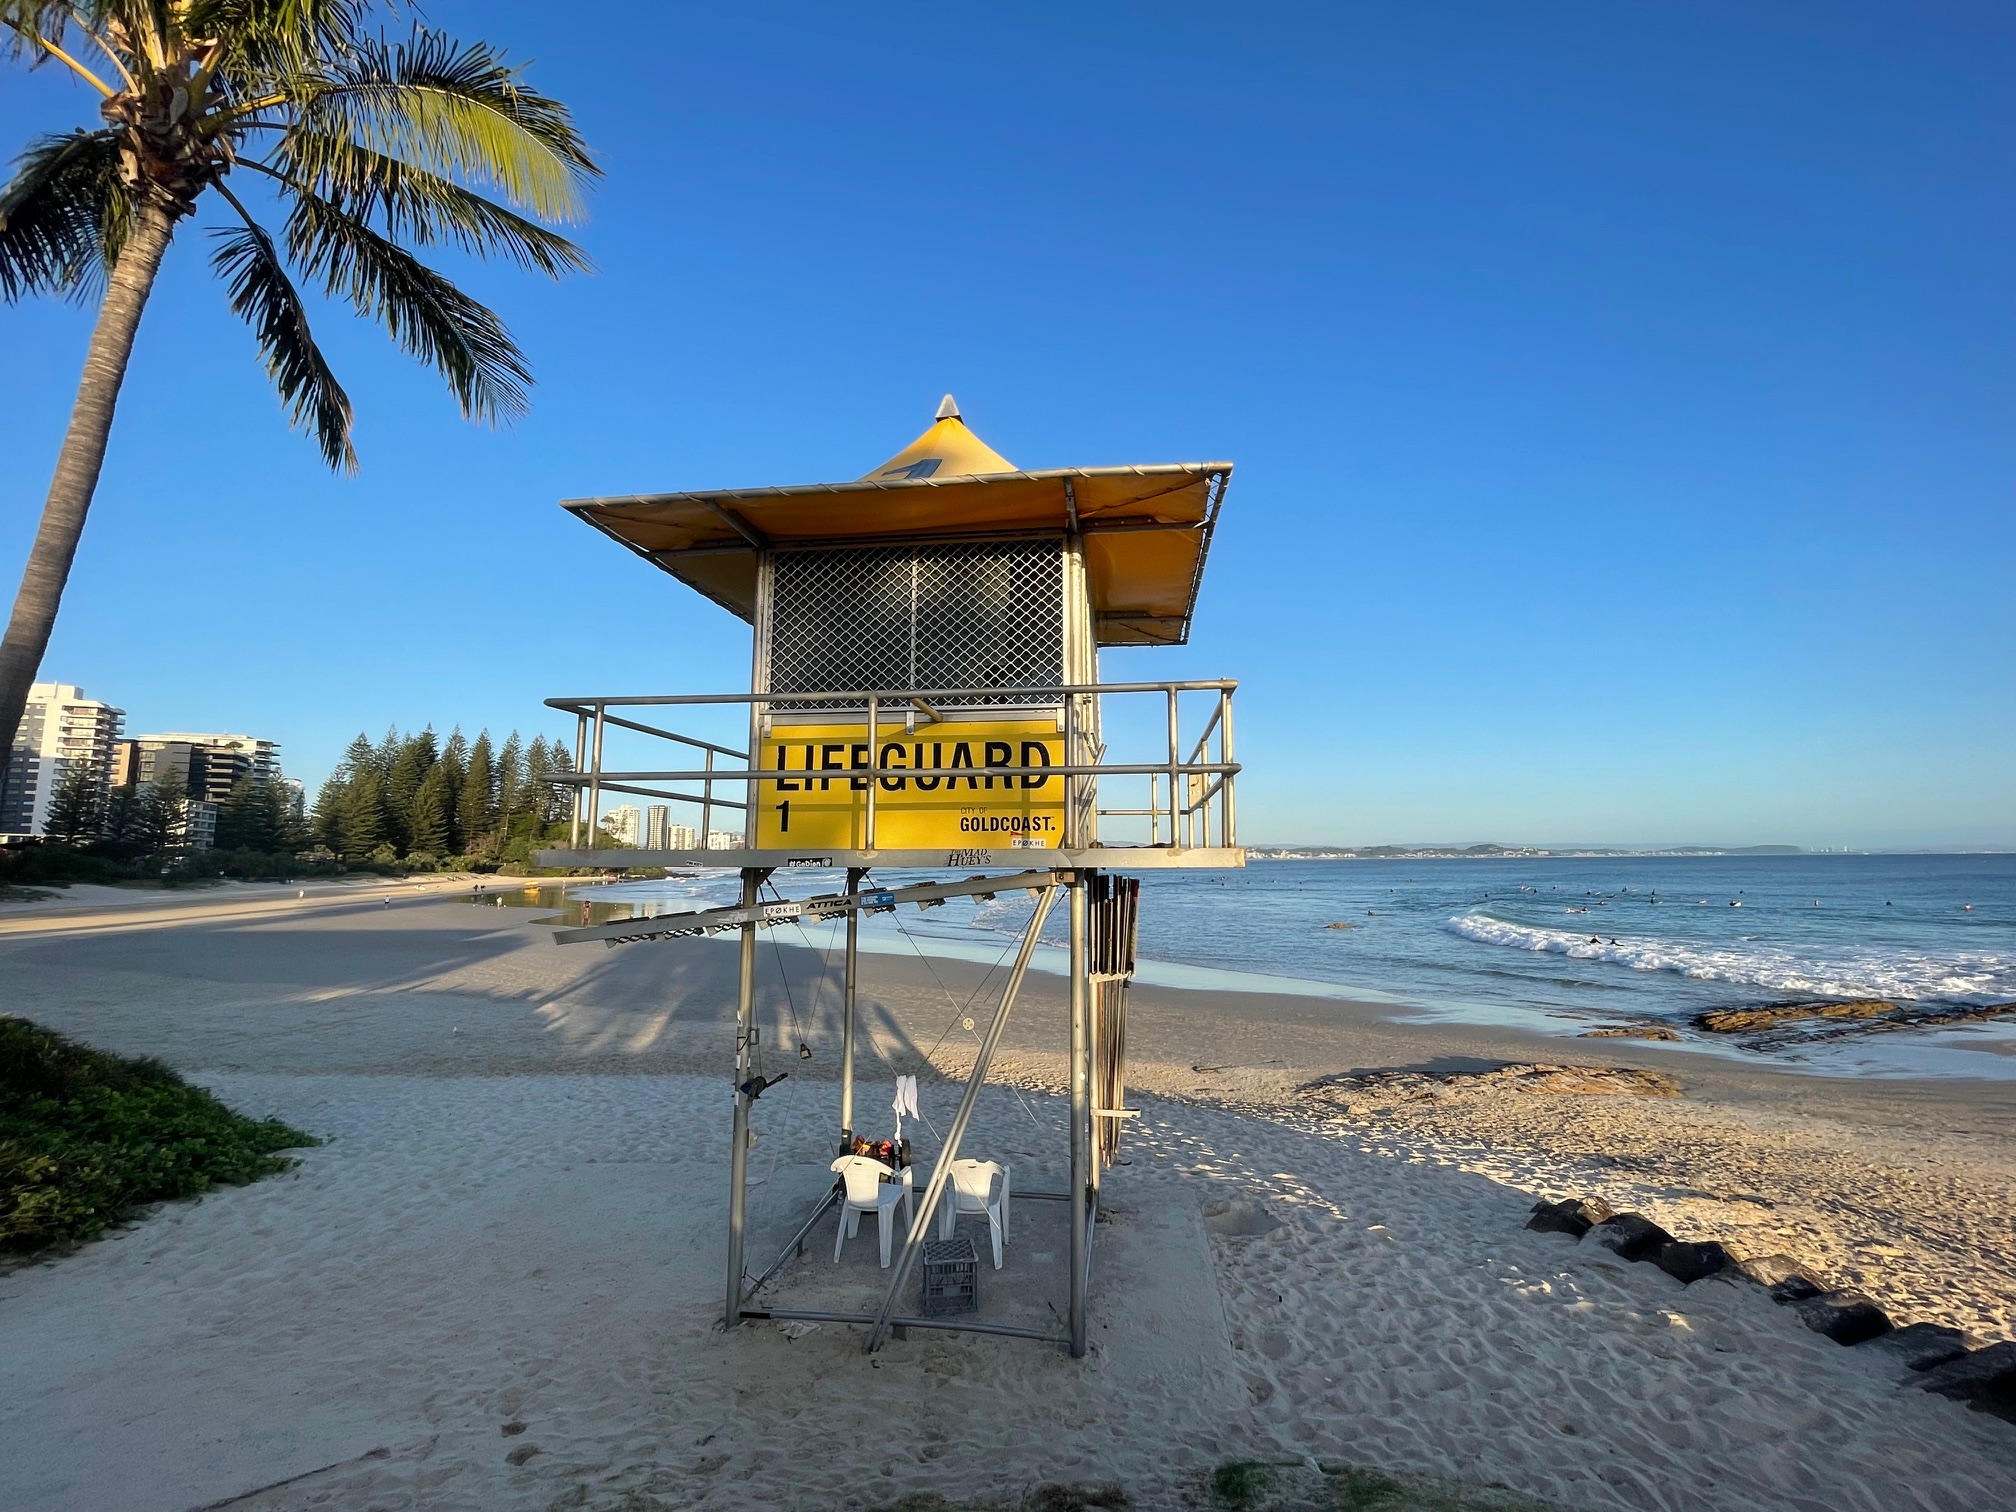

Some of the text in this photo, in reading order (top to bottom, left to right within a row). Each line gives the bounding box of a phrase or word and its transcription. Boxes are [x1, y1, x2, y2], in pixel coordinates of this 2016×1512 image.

[776, 742, 1050, 790] LIFEGUARD
[776, 800, 789, 832] 1
[806, 899, 852, 909] ATTICA
